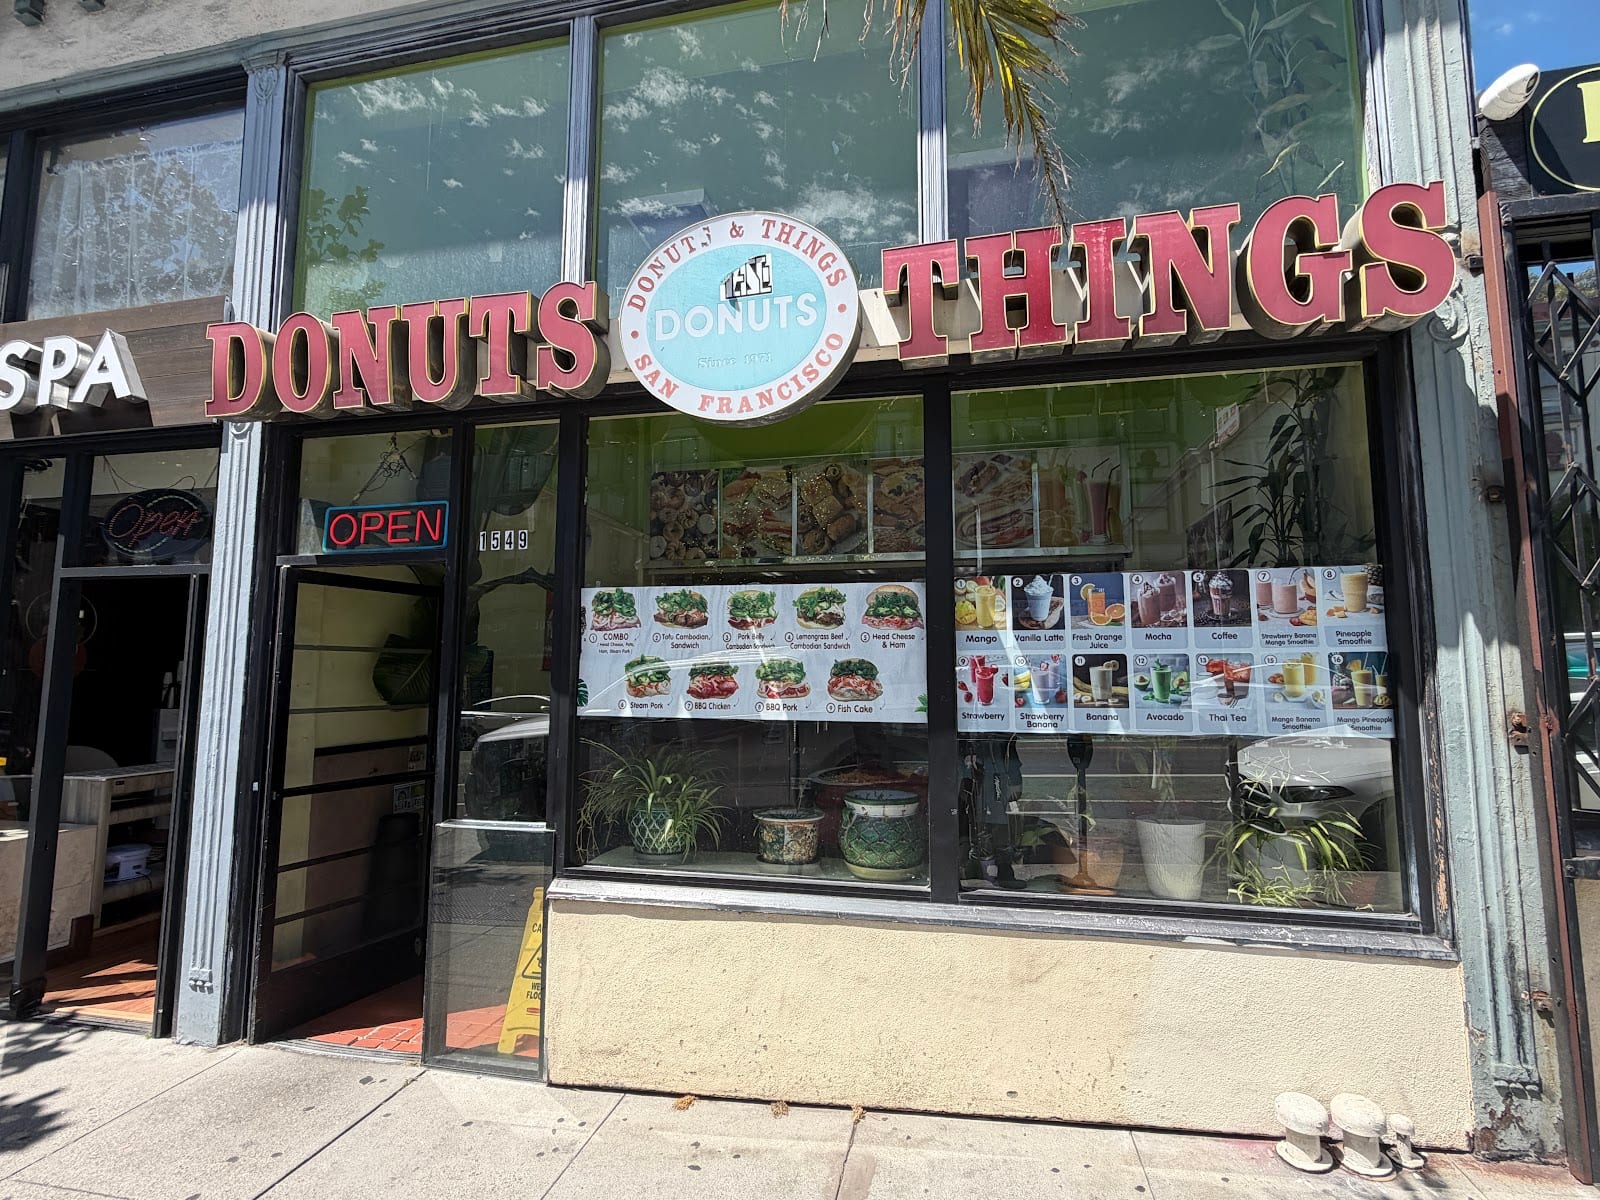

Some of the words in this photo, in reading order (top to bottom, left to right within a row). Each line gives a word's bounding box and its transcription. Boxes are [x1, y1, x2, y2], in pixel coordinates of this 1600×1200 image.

[729, 220, 745, 239] &
[762, 218, 847, 287] THINGS
[882, 180, 1457, 361] THINGS
[655, 293, 817, 341] DONUTS
[205, 281, 599, 418] DONUTS
[0, 328, 135, 411] SPA
[635, 354, 679, 400] SAN
[698, 333, 844, 414] FRANCISCO
[109, 504, 198, 548] Open
[329, 508, 443, 547] OPEN
[480, 531, 527, 550] 1549
[603, 632, 629, 641] COMBO
[676, 632, 709, 640] Cambodian
[752, 632, 765, 641] Blly
[796, 632, 829, 641] Lemongrass
[965, 635, 997, 643] Mango
[1014, 634, 1040, 642] Vanilla
[1044, 634, 1064, 642] Latte
[1095, 633, 1123, 643] Orange
[1211, 632, 1238, 640] Coffee
[1336, 630, 1372, 639] Pineapple
[708, 702, 731, 710] Chicken
[782, 704, 798, 712] Pork
[837, 705, 852, 713] Fish
[854, 705, 873, 713] Cake
[962, 712, 1005, 720] Strawberry
[1020, 713, 1064, 722] Strawberry
[1146, 712, 1184, 721] Avocado
[1209, 714, 1227, 722] Thai
[1231, 714, 1247, 722] Tea
[532, 923, 542, 932] CA
[532, 982, 542, 990] WE
